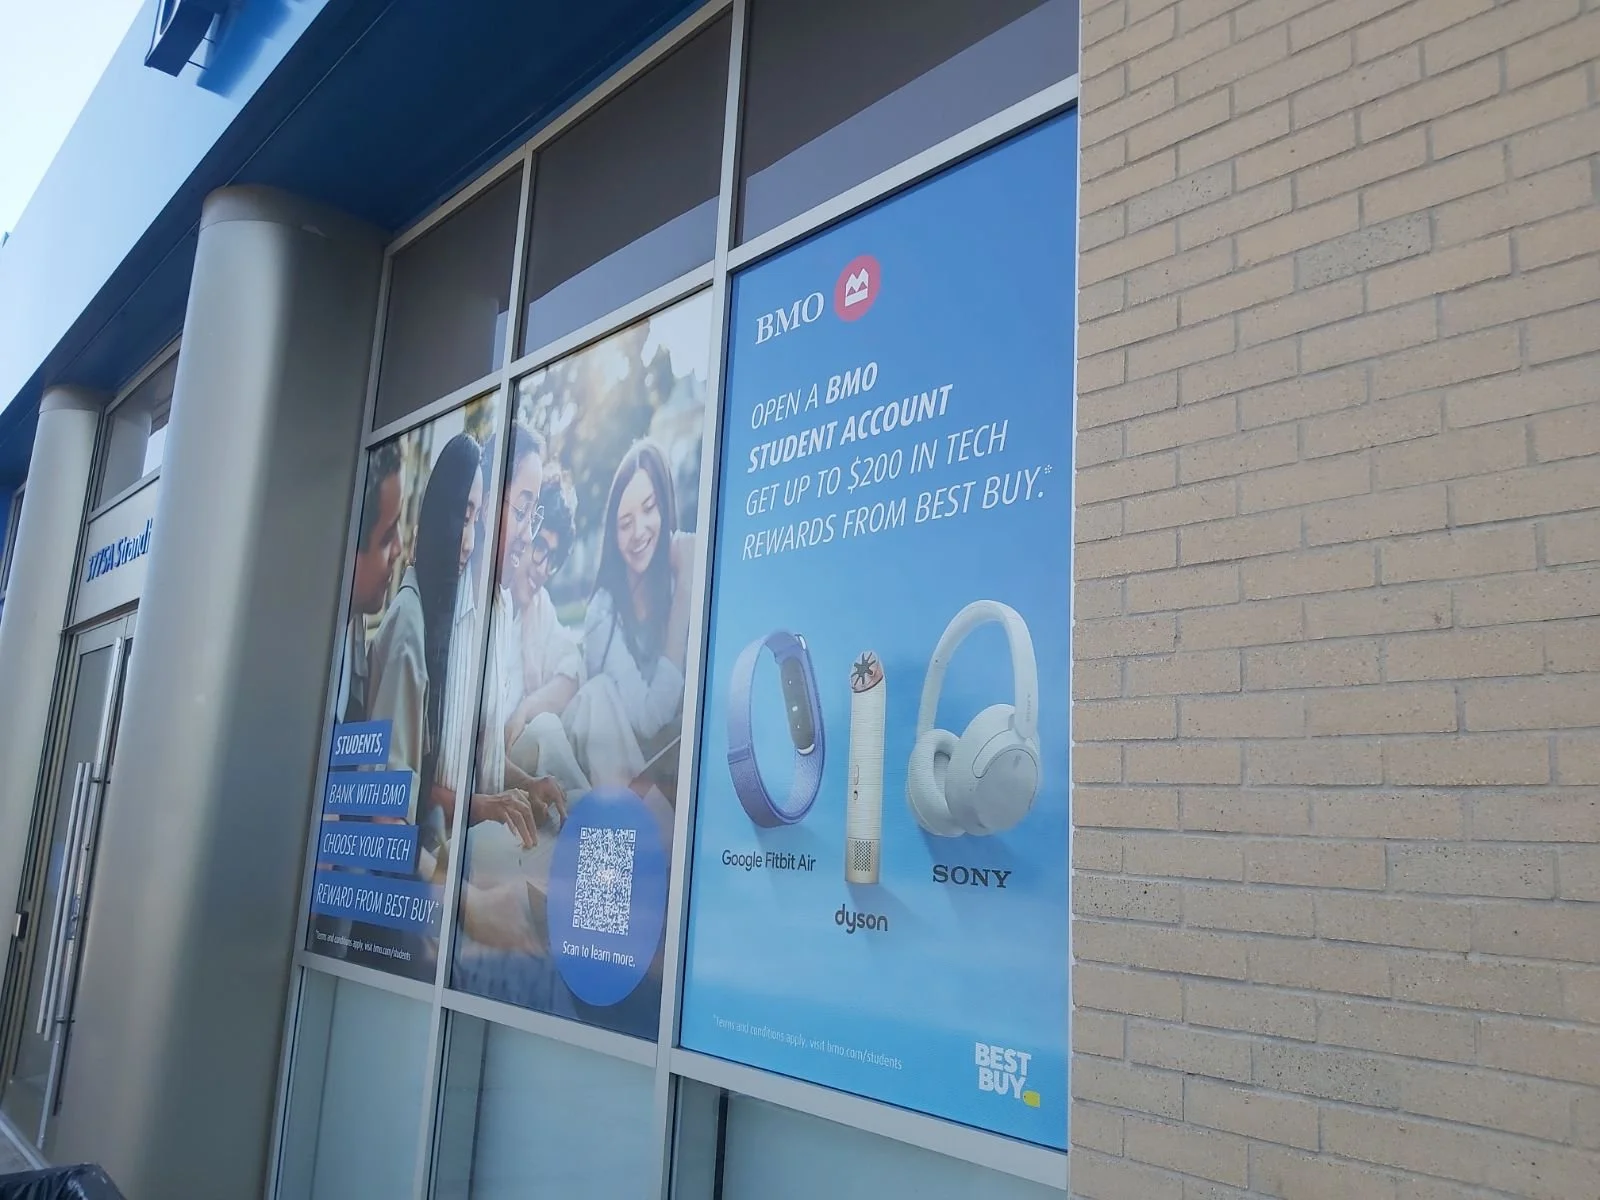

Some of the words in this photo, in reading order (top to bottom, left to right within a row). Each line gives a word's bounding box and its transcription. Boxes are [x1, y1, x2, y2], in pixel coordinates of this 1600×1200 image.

[755, 291, 825, 344] BMO
[751, 388, 801, 429] OPEN
[805, 383, 820, 412] A
[825, 362, 878, 405] BMO
[748, 421, 838, 473] STUDENT
[840, 384, 953, 446] ACCOUNT
[746, 483, 780, 516] GET
[783, 474, 811, 507] UP
[817, 466, 841, 499] TO
[848, 449, 903, 493] $200
[910, 440, 938, 475] IN
[947, 419, 1009, 465] TECH
[742, 513, 837, 561] REWARDS
[842, 497, 907, 539] FROM
[914, 481, 976, 523] BEST
[335, 733, 384, 757] STUDENTS,
[329, 784, 355, 804] BANK
[356, 784, 380, 805] WITH
[381, 784, 406, 806] BMO
[323, 833, 357, 857] CHOOSE
[359, 836, 384, 860] YOUR
[386, 838, 411, 862] TECH
[721, 849, 763, 872] Google
[765, 852, 796, 871] Fitbit
[797, 853, 817, 873] Air
[932, 863, 1012, 889] SONY
[316, 883, 354, 909] REWARD
[355, 888, 383, 914] FROM
[384, 893, 411, 919] BEST
[834, 903, 889, 935] dyson
[334, 935, 352, 947] conditions
[373, 942, 411, 961] bmo.com/students
[562, 940, 580, 957] Scan
[581, 944, 589, 959] to
[591, 944, 611, 963] learn
[612, 952, 636, 968] more.
[736, 1022, 749, 1034] and
[750, 1025, 785, 1042] conditions
[809, 1038, 825, 1052] visit
[827, 1040, 902, 1071] bmo.com/students
[975, 1041, 1032, 1076] BEST
